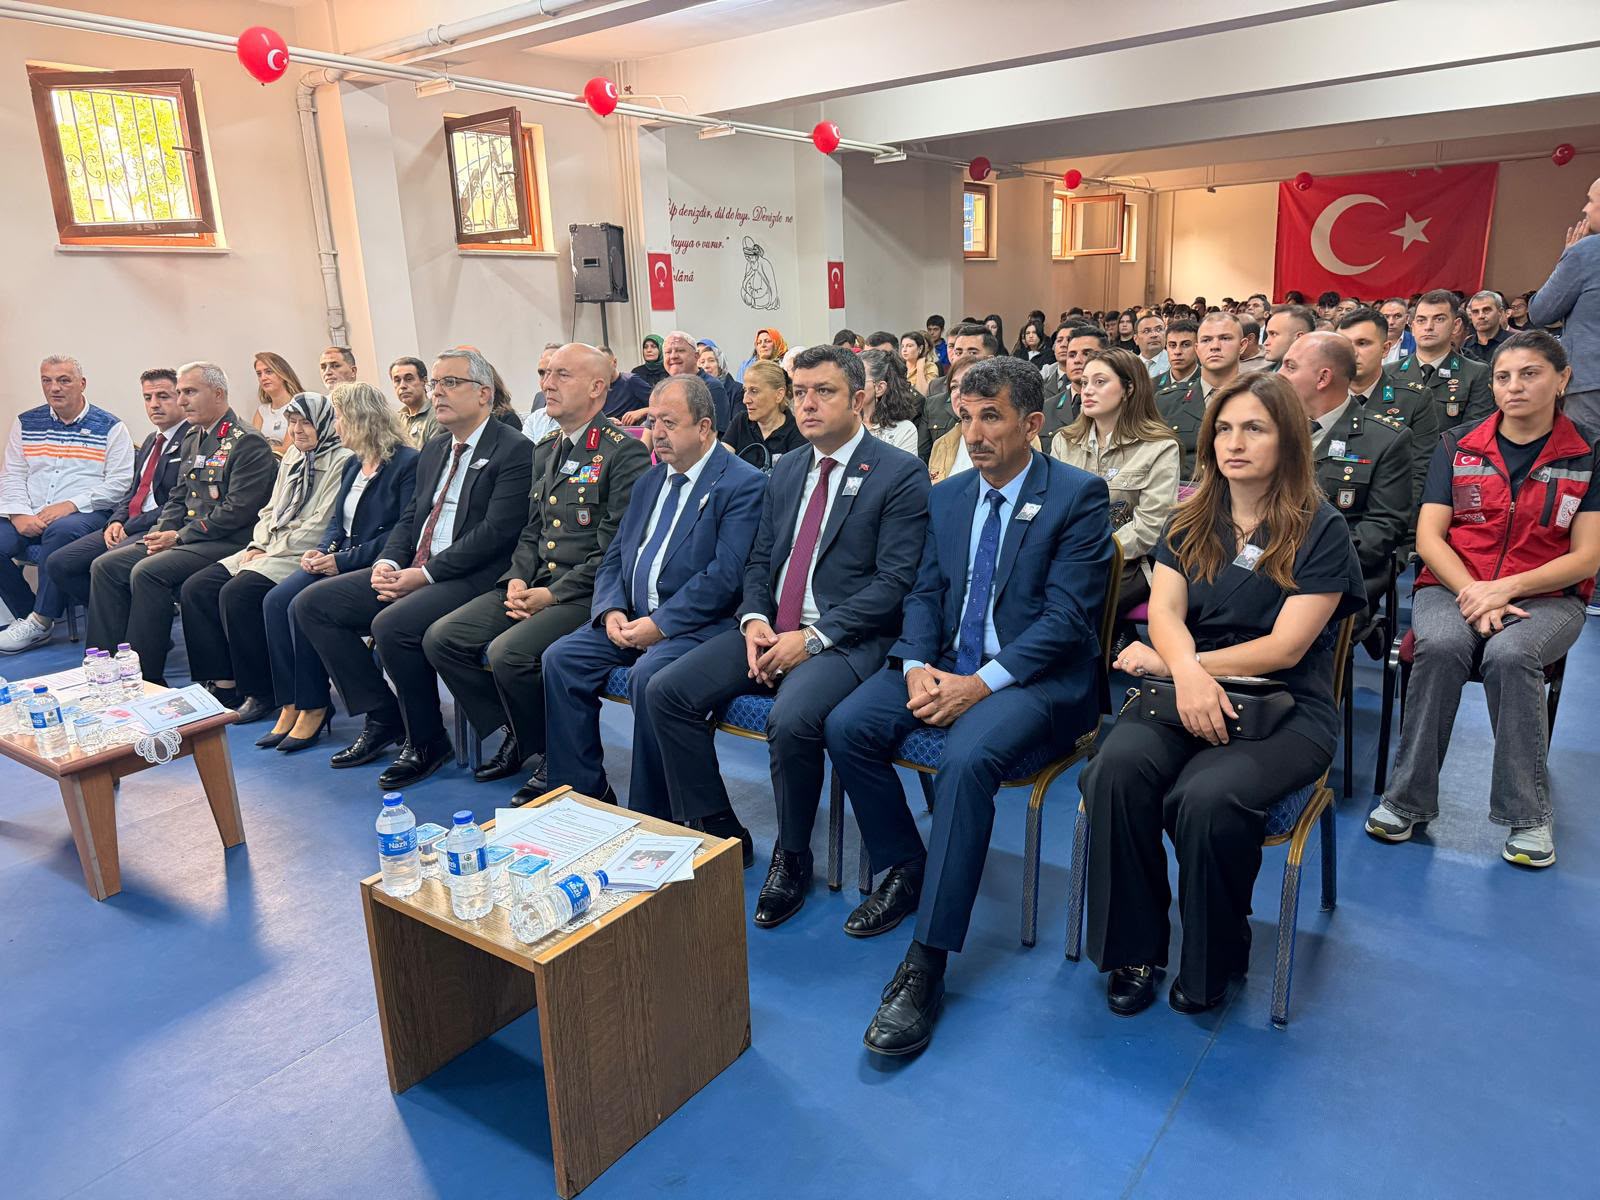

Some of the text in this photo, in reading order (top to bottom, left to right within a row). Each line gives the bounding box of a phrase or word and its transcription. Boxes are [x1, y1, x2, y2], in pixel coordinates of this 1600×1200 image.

[679, 204, 712, 224] denizdir,
[714, 206, 726, 218] dil
[726, 207, 734, 219] de
[752, 206, 782, 228] Denizde
